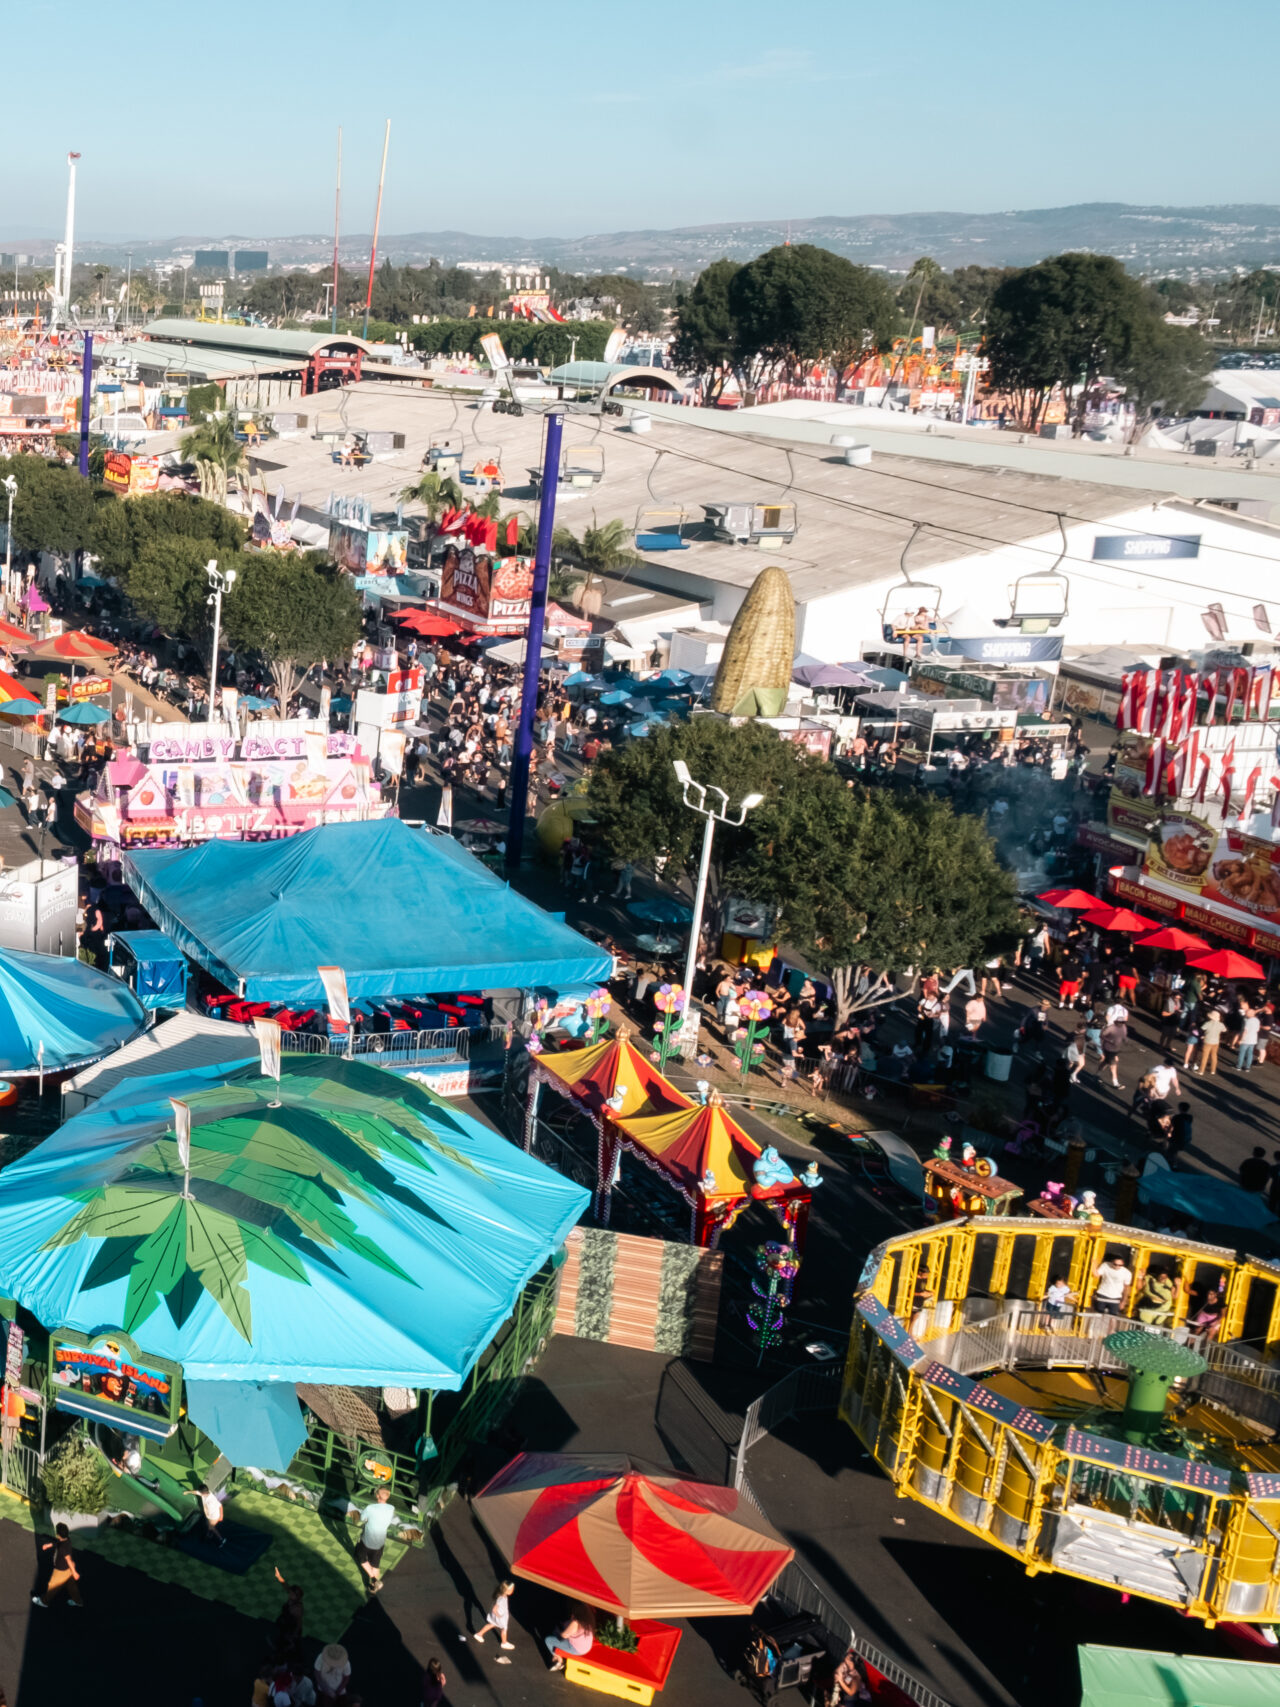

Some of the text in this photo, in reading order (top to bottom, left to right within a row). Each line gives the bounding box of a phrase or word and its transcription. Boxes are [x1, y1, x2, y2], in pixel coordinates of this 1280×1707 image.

[1123, 541, 1171, 555] SHOPPING
[453, 568, 478, 594] PIZZA
[456, 592, 473, 607] WINGS
[492, 600, 531, 616] PIZZA
[981, 642, 1032, 658] SHOPPING
[959, 673, 986, 693] FRIES
[152, 736, 355, 757] CANDY FACTRY
[1120, 881, 1178, 909] BACON SHRIMP
[1185, 906, 1248, 938] MAUI CHICKEN
[55, 1349, 118, 1371] SURVIVAL
[120, 1362, 170, 1394] ISLAND
